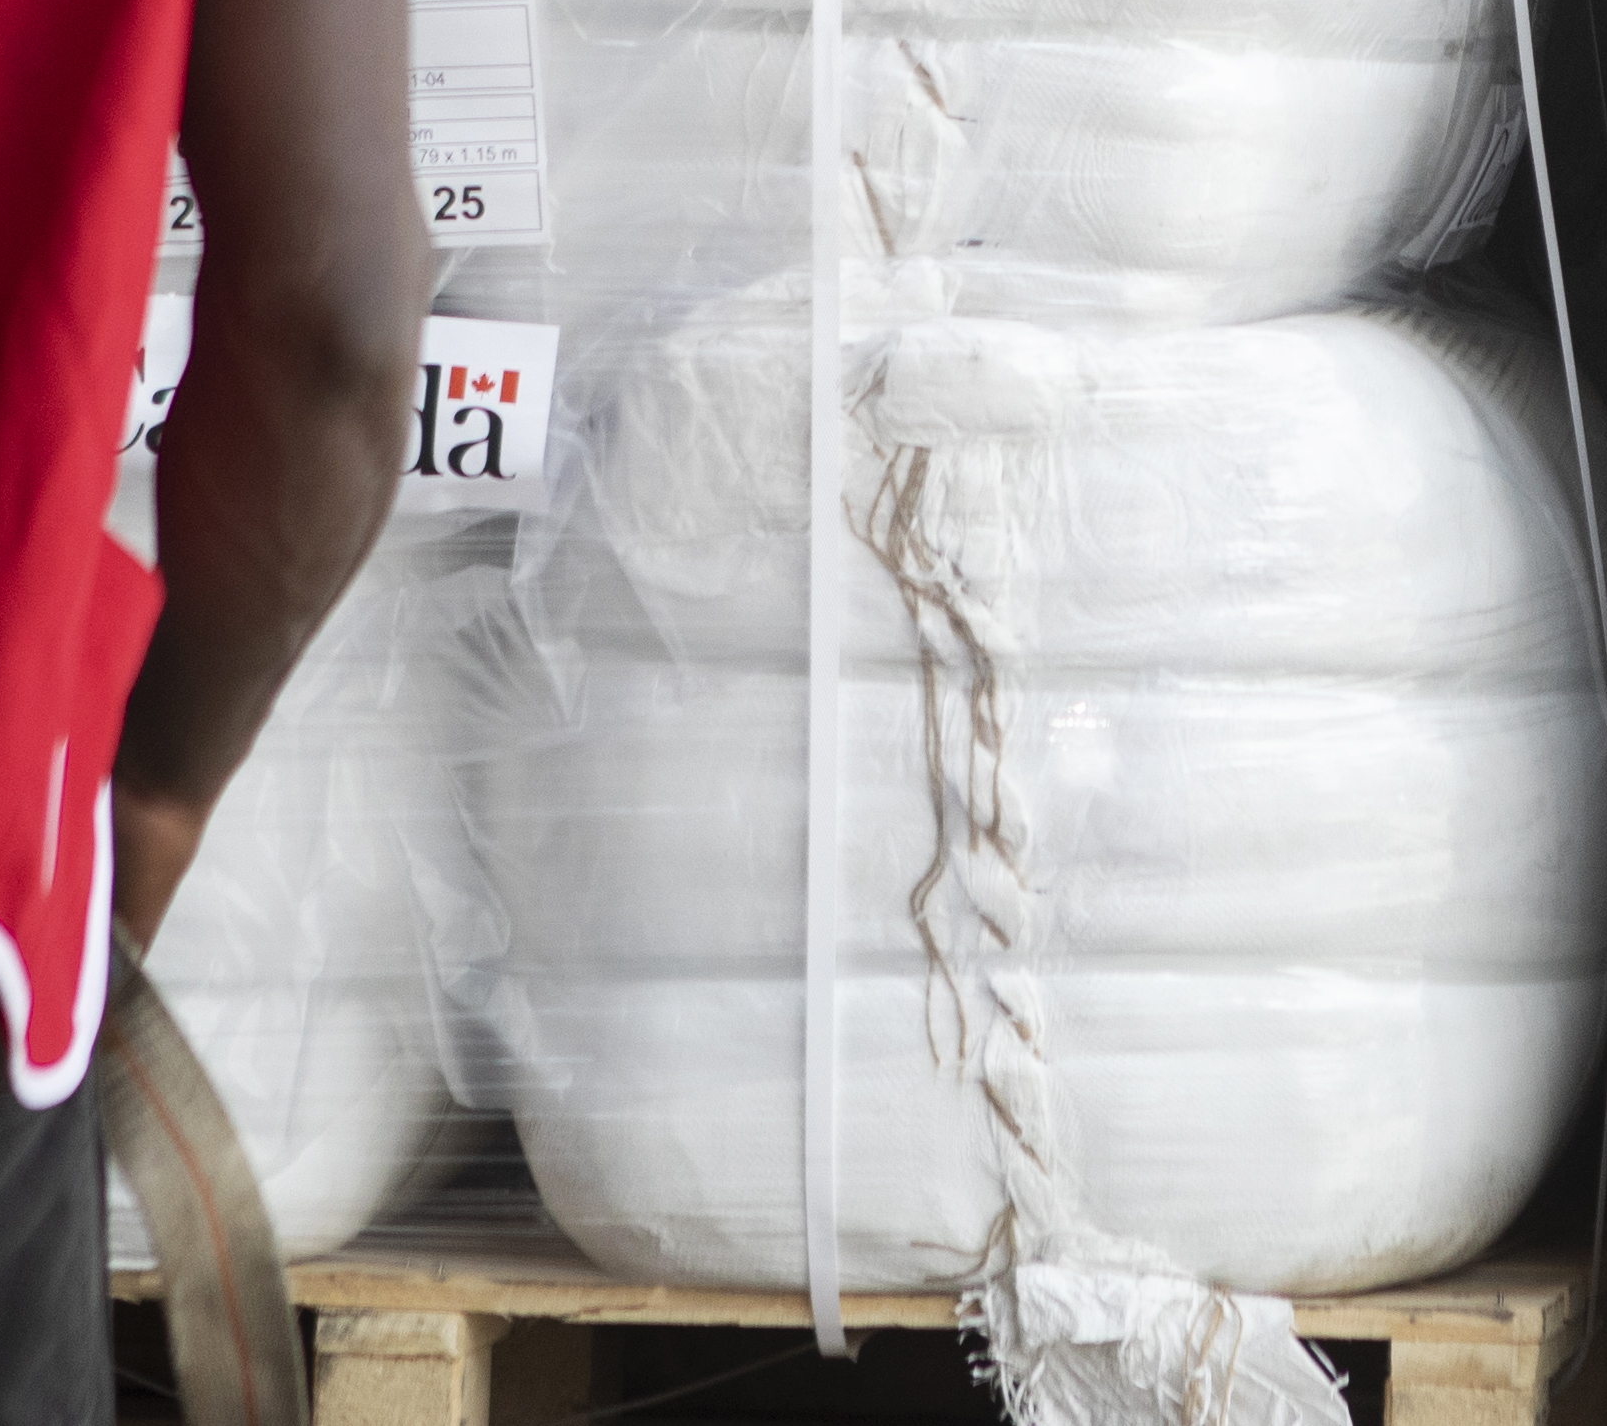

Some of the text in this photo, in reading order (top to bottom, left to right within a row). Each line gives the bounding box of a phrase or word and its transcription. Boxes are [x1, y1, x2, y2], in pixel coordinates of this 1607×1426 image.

[460, 146, 497, 164] 1.15
[502, 148, 518, 161] m
[432, 185, 486, 222] 25
